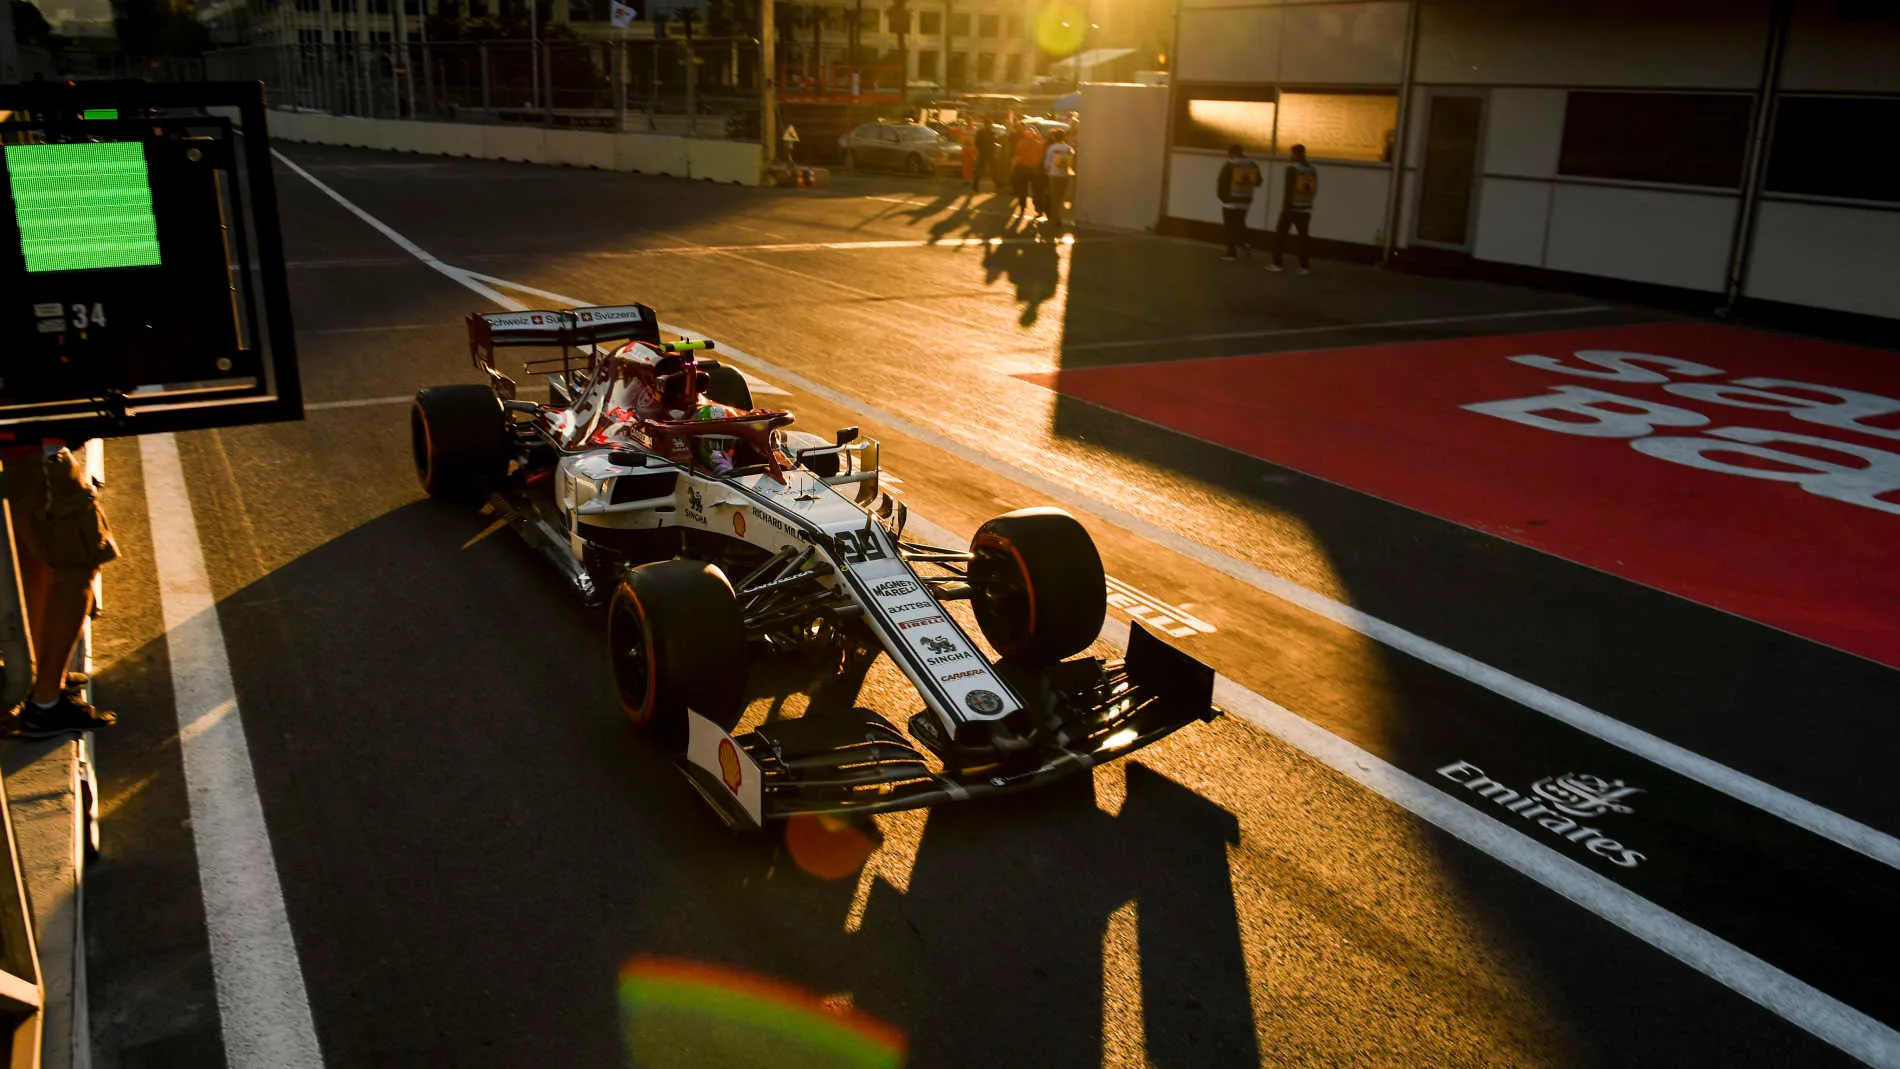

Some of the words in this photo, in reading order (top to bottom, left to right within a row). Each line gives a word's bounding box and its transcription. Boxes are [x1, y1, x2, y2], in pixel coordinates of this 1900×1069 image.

[72, 302, 107, 329] 34
[594, 311, 637, 321] Svizzera
[752, 506, 782, 531] RICHARD
[898, 615, 945, 630] PIRELLI
[927, 651, 973, 665] SINGHA
[941, 668, 985, 682] CARRERA
[1435, 759, 1648, 868] Emirates
